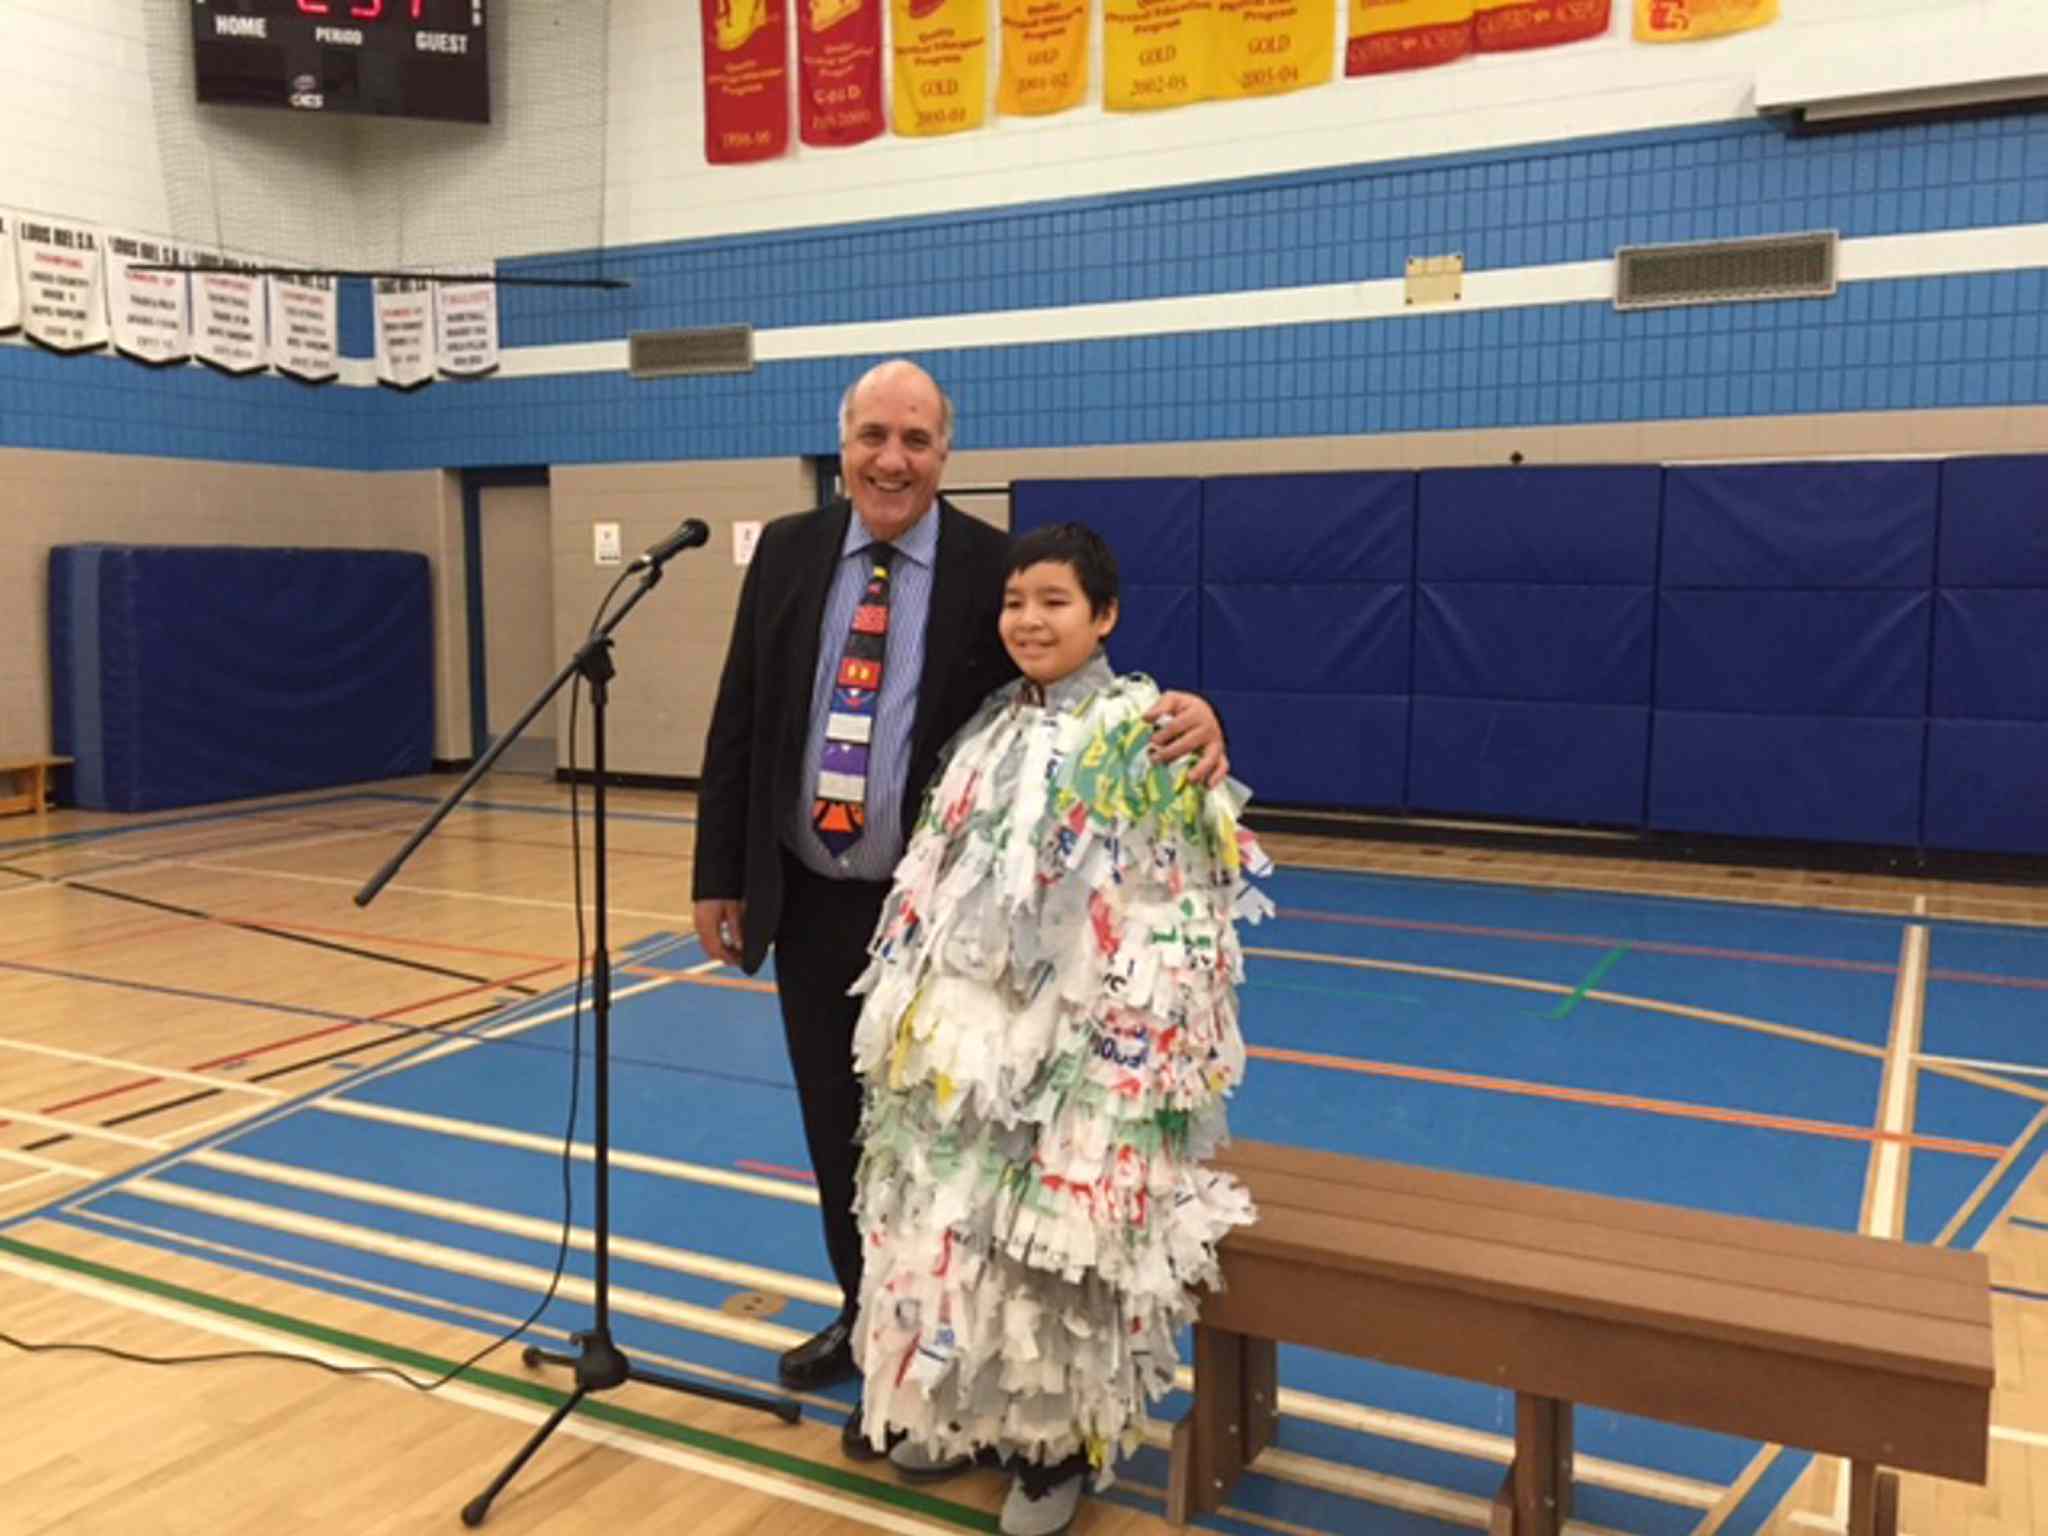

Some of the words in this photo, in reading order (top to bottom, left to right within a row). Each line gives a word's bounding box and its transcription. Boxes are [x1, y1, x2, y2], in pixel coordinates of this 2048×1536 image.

[215, 15, 267, 38] HOME
[315, 27, 363, 45] PERIOD
[415, 31, 468, 54] GUEST
[1248, 34, 1291, 55] GOLD
[1139, 44, 1177, 66] GOLD
[920, 78, 959, 98] GOLD
